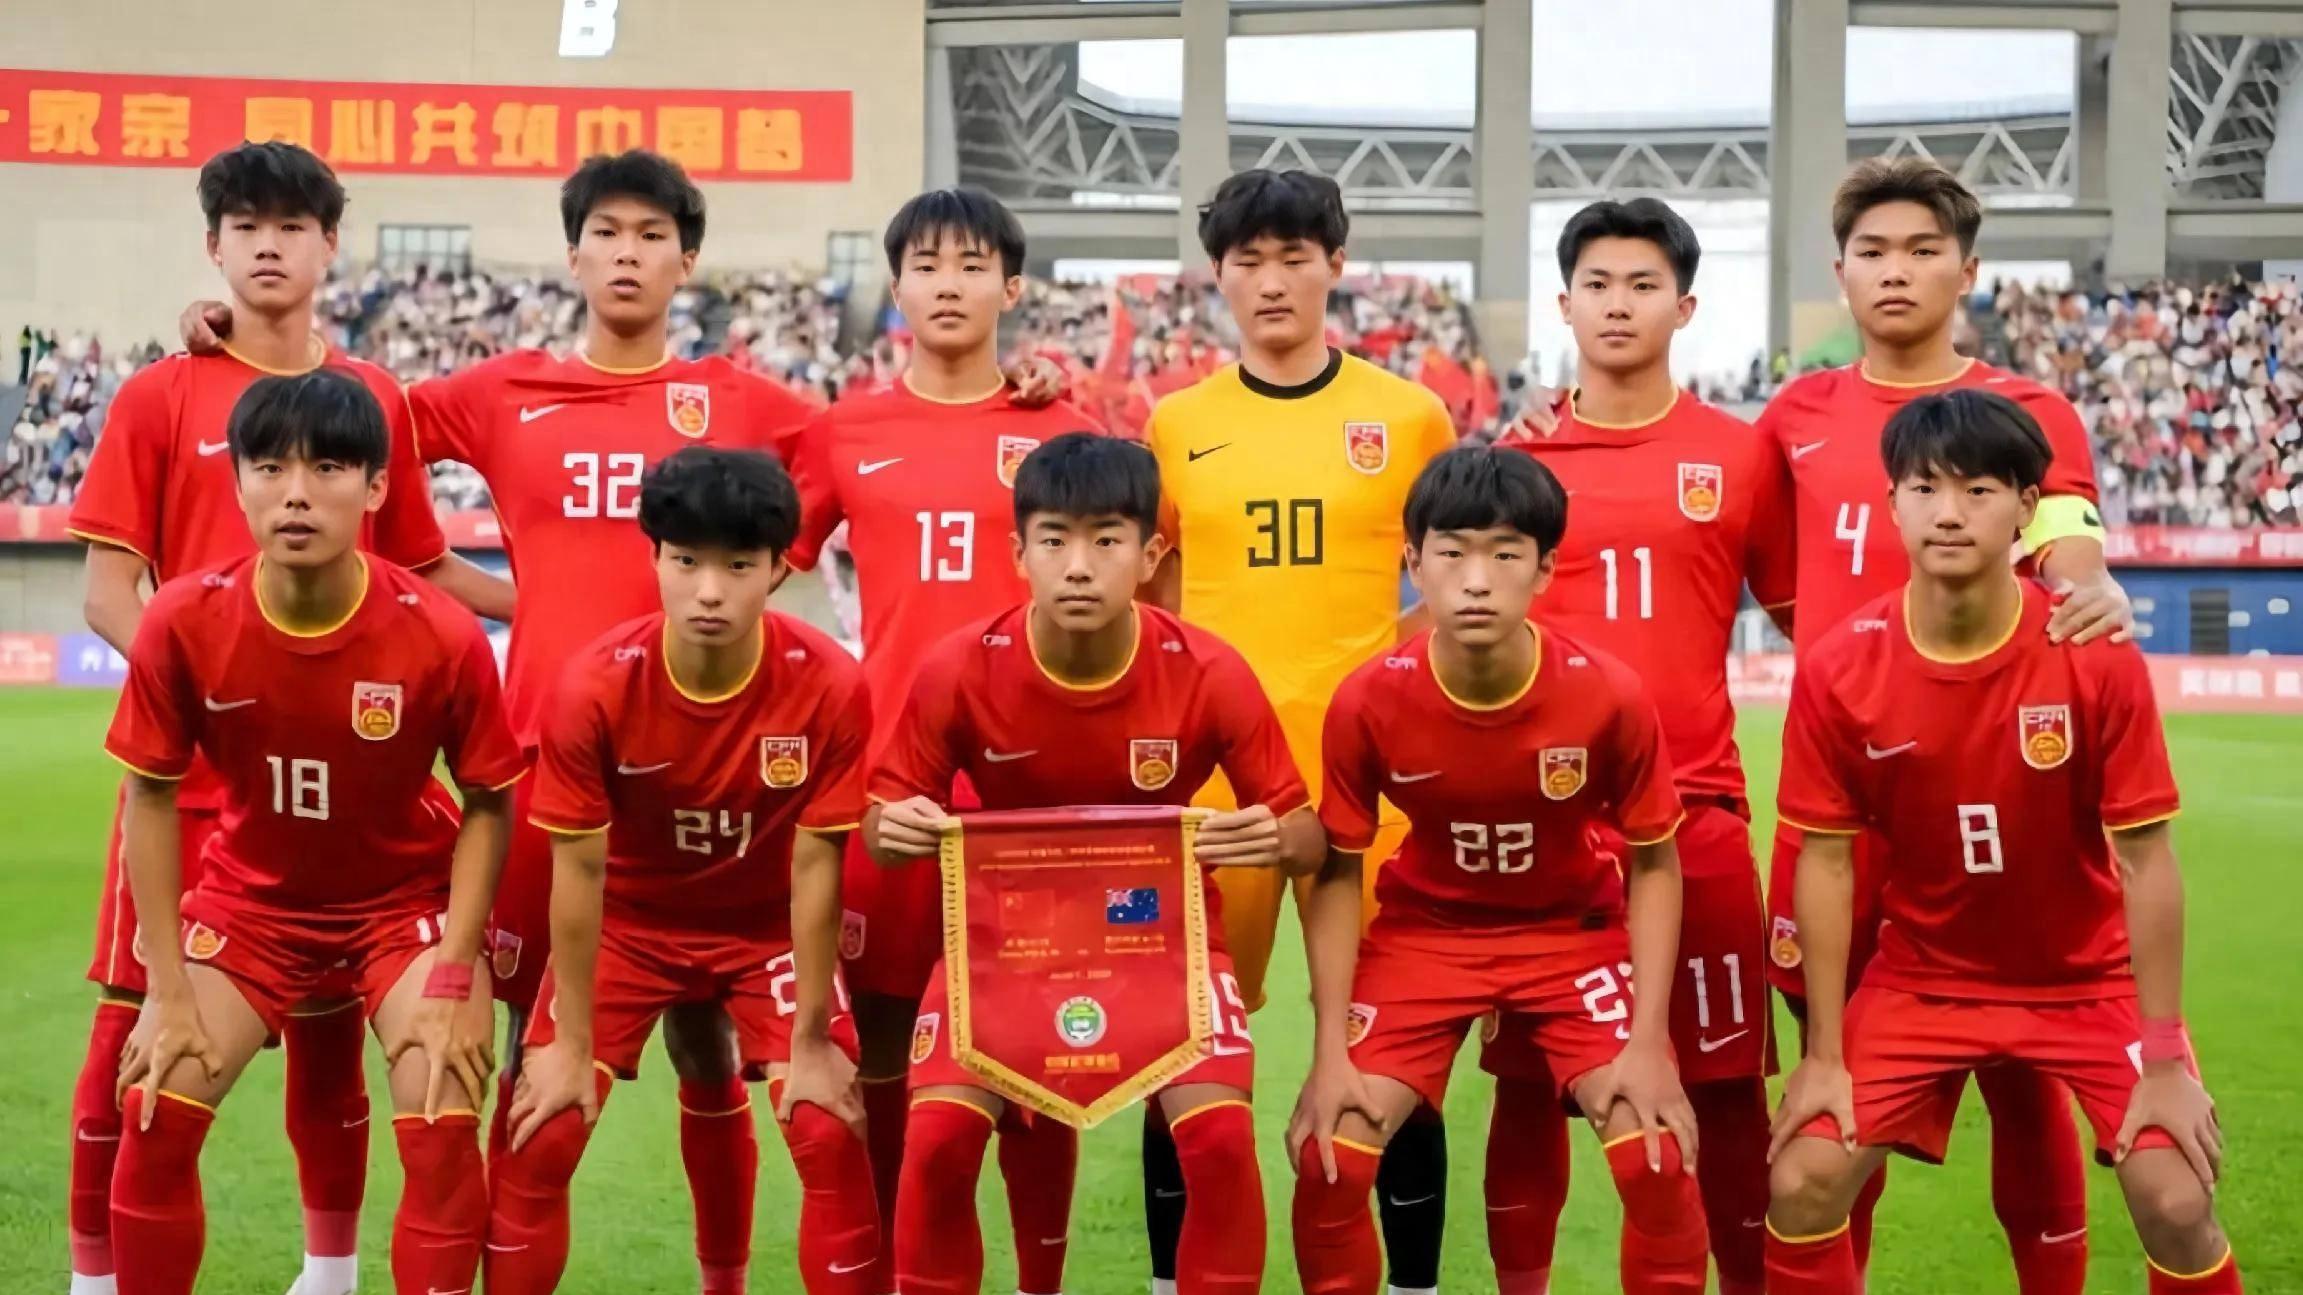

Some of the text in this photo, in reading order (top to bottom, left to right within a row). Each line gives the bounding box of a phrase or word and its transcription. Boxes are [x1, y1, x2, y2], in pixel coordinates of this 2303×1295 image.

[563, 453, 644, 518] 32
[916, 511, 975, 582] 13
[1245, 498, 1324, 568] 30
[1836, 502, 1870, 576] 4
[1599, 547, 1653, 620] 11
[266, 754, 330, 821] 18
[674, 809, 752, 858] 24
[1450, 822, 1534, 873] 22
[1957, 804, 2003, 874] 8
[1688, 953, 1745, 1027] 11
